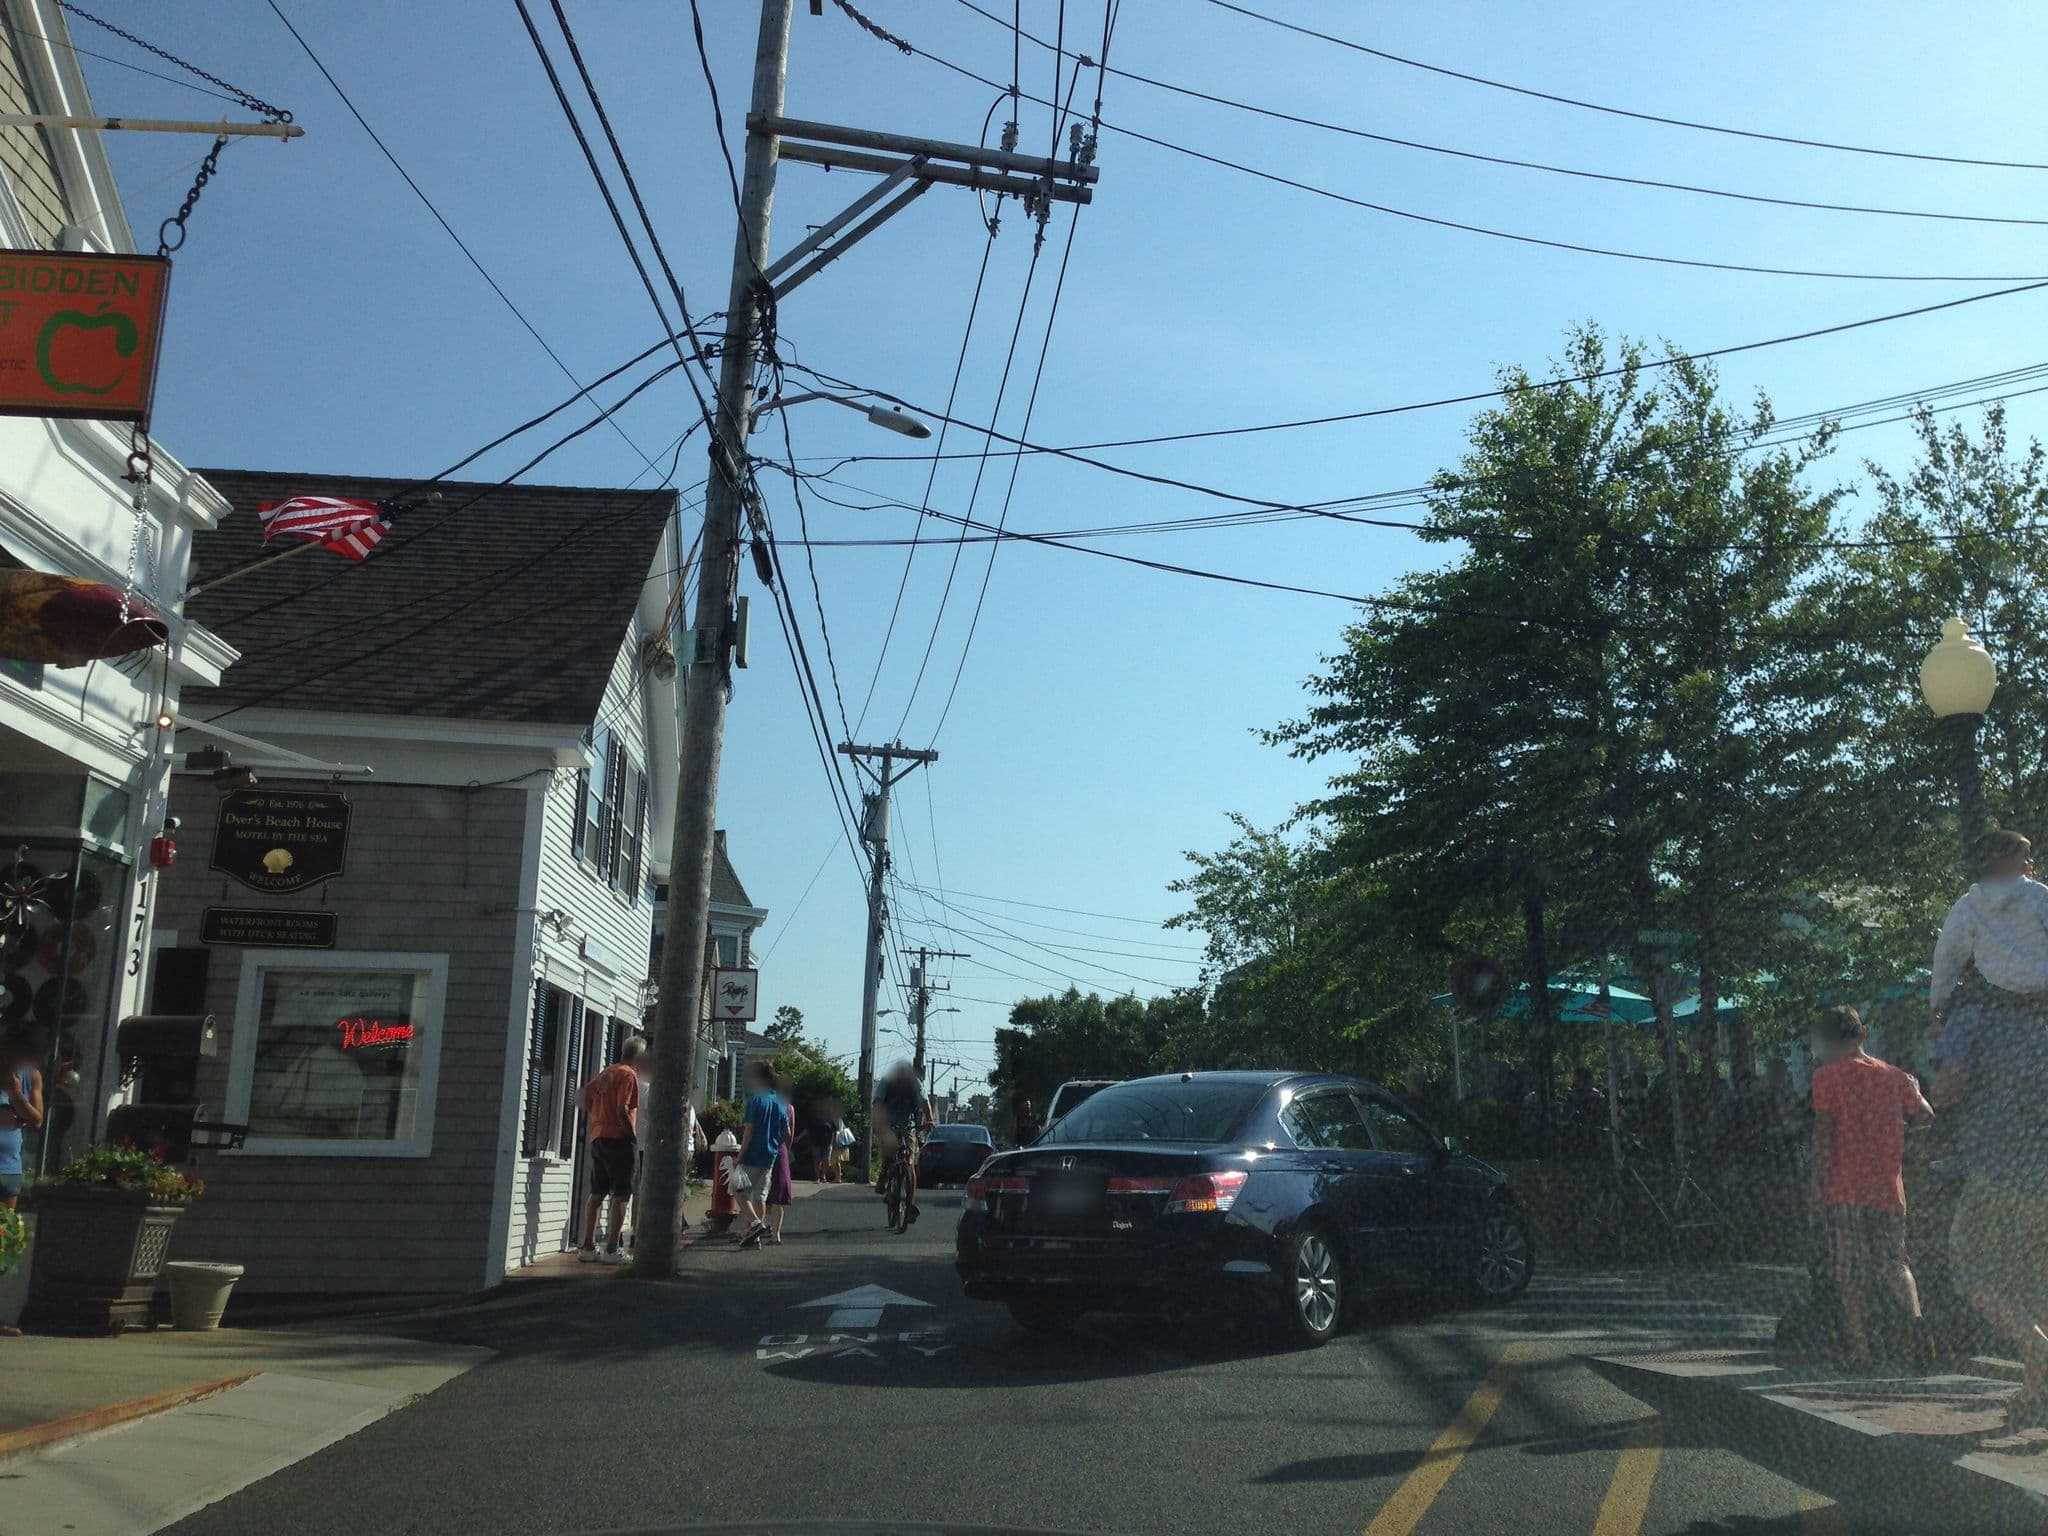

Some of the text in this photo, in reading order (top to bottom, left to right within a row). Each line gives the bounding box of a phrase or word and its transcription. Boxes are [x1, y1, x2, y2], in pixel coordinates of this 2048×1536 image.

[225, 813, 343, 830] Dyer's Beach House
[236, 831, 328, 843] MOTEL BY THE SEA
[249, 872, 303, 887] WELCOME
[128, 881, 147, 976] 173
[220, 916, 320, 929] WATERFRONT ROOMS
[338, 1017, 414, 1048] Welcome
